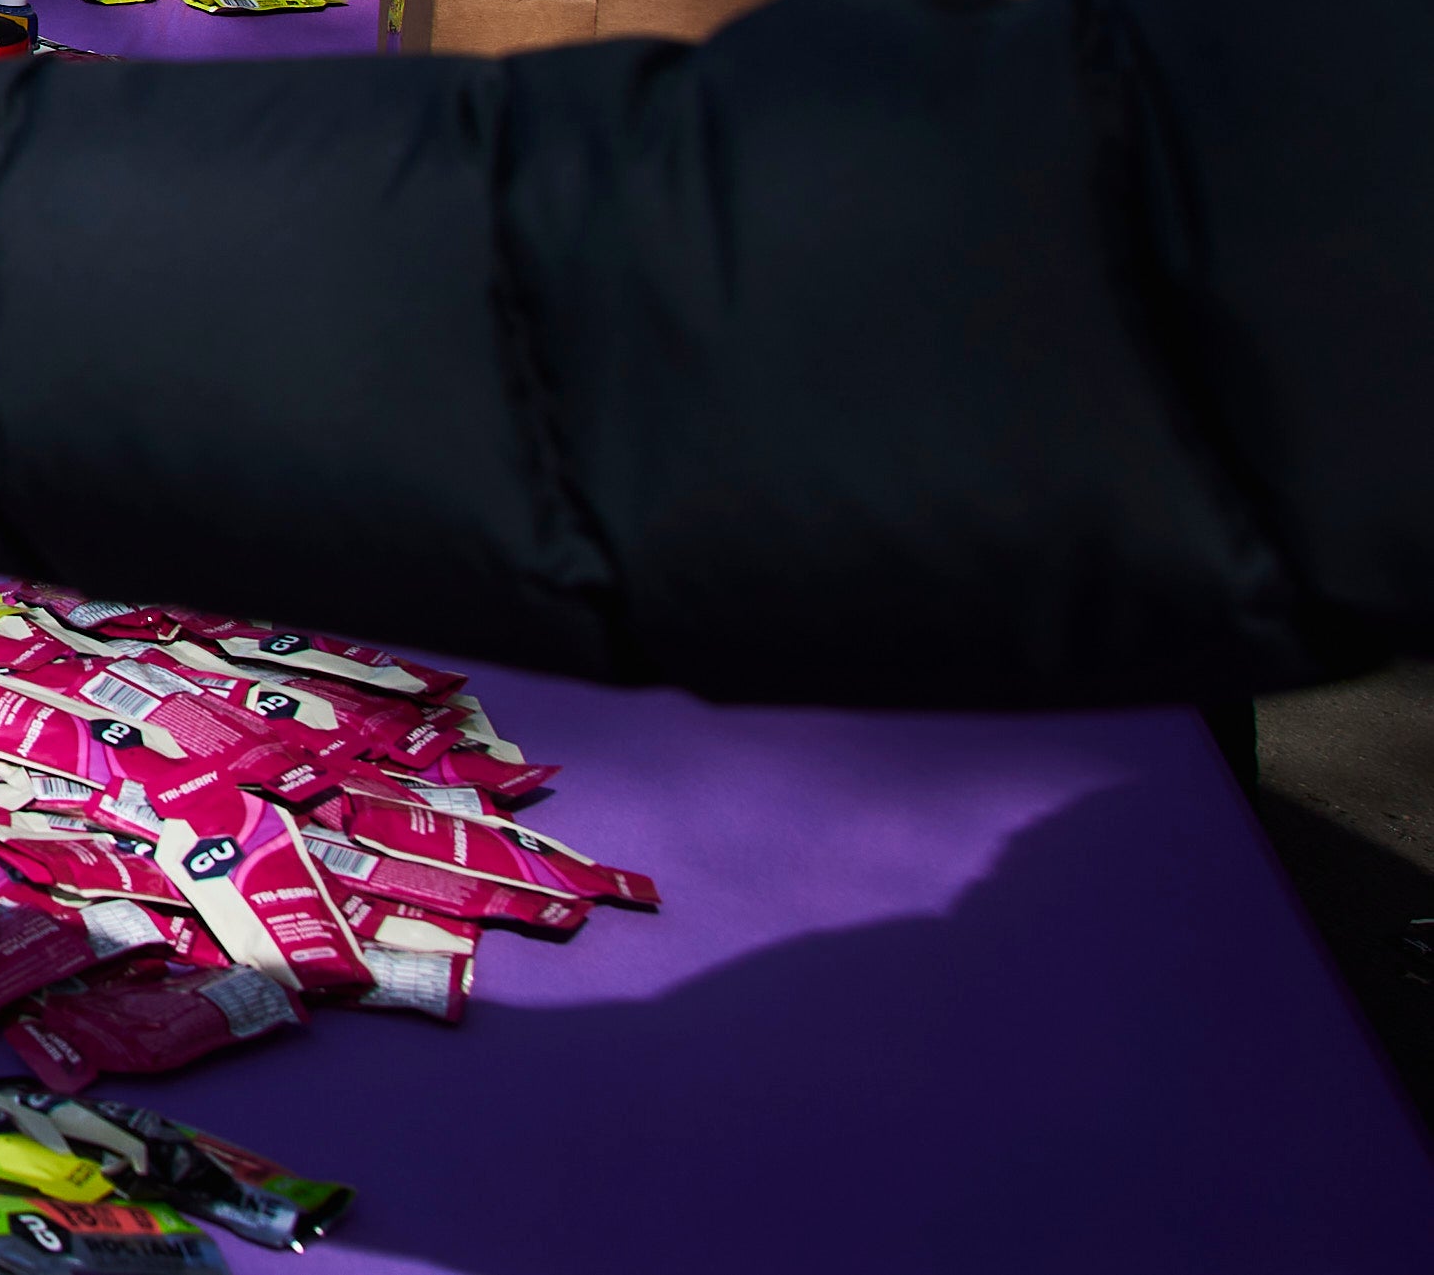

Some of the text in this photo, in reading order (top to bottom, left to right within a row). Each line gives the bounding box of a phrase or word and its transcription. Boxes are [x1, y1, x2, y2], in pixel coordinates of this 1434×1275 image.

[270, 634, 300, 652] GU
[16, 706, 56, 758] TRI-BERRY
[101, 723, 131, 745] GU
[158, 771, 219, 804] TRI-BERRY
[190, 840, 235, 873] GU
[19, 1214, 63, 1250] GU
